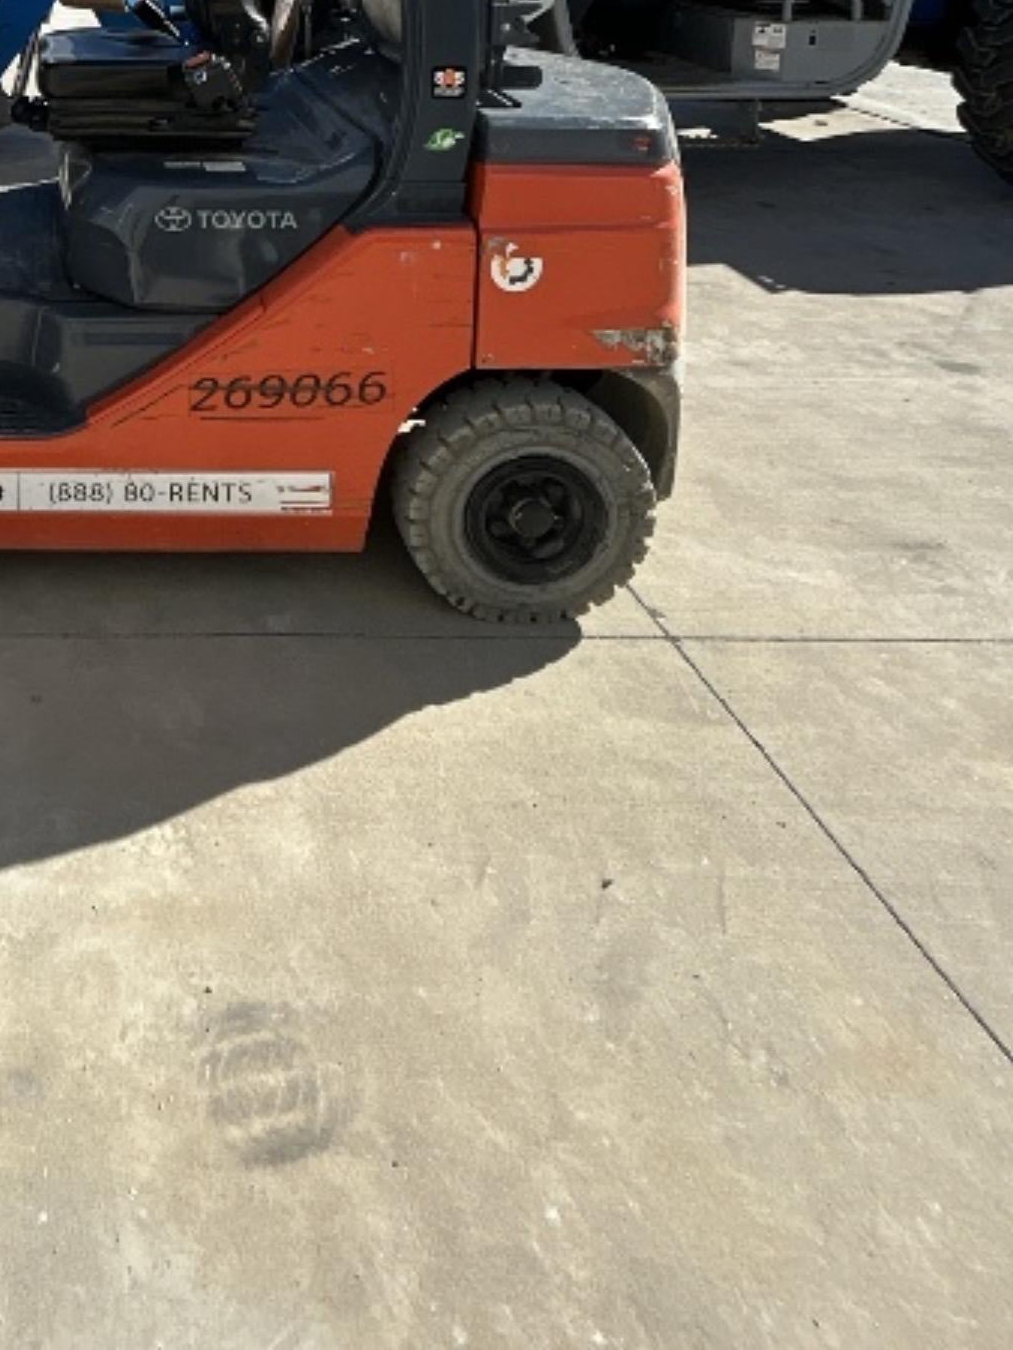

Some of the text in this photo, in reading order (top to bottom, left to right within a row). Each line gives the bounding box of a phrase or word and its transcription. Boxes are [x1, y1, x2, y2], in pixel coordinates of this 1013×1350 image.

[196, 209, 299, 230] TOYOTA
[190, 371, 387, 412] 269066
[48, 481, 114, 506] (888)
